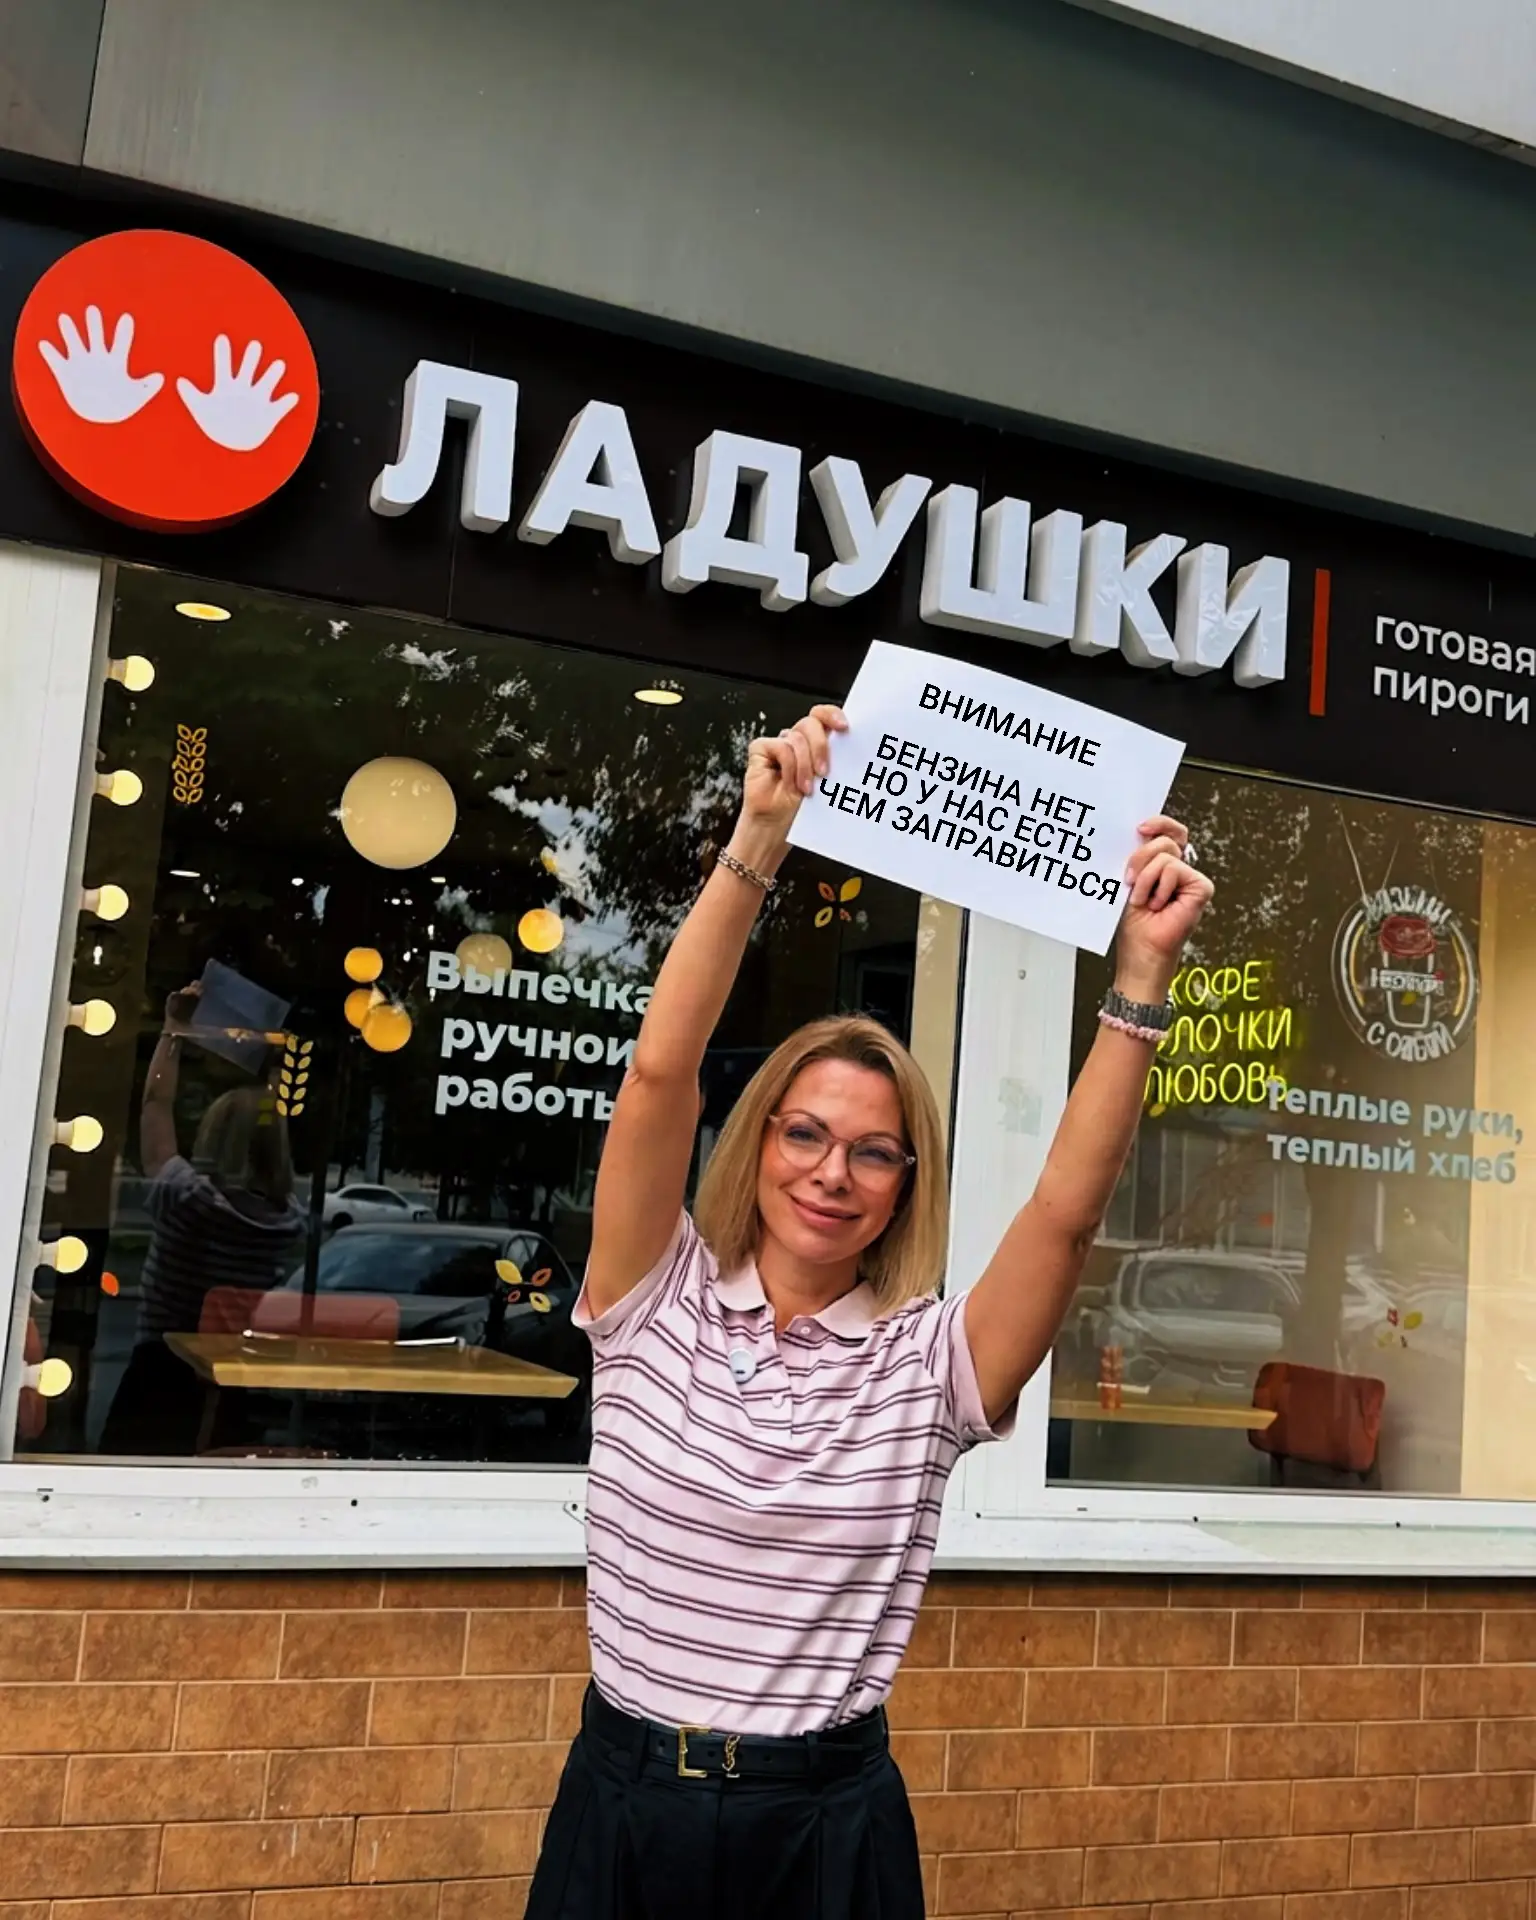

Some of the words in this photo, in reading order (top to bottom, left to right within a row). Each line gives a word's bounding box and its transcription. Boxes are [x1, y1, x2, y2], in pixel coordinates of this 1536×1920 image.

[369, 359, 1290, 688] ЛАДУШКИ
[1375, 615, 1536, 677] готовая
[918, 683, 1102, 768] ВНИМАНИЕ
[1373, 666, 1530, 725] пироги
[861, 762, 909, 797] НО
[915, 782, 940, 806] У
[942, 790, 1010, 833] НАС
[1013, 814, 1093, 862] ЕСТЬ
[876, 733, 1021, 806] БЕНЗИНА
[1031, 787, 1096, 837] НЕТ,
[818, 777, 887, 826] ЧЕМ
[891, 805, 1122, 905] ЗАПРАВИТЬСЯ
[1144, 1061, 1287, 1104] ЛЮБОВЬ
[1266, 1133, 1416, 1175] теплый
[1423, 1103, 1524, 1145] руки,
